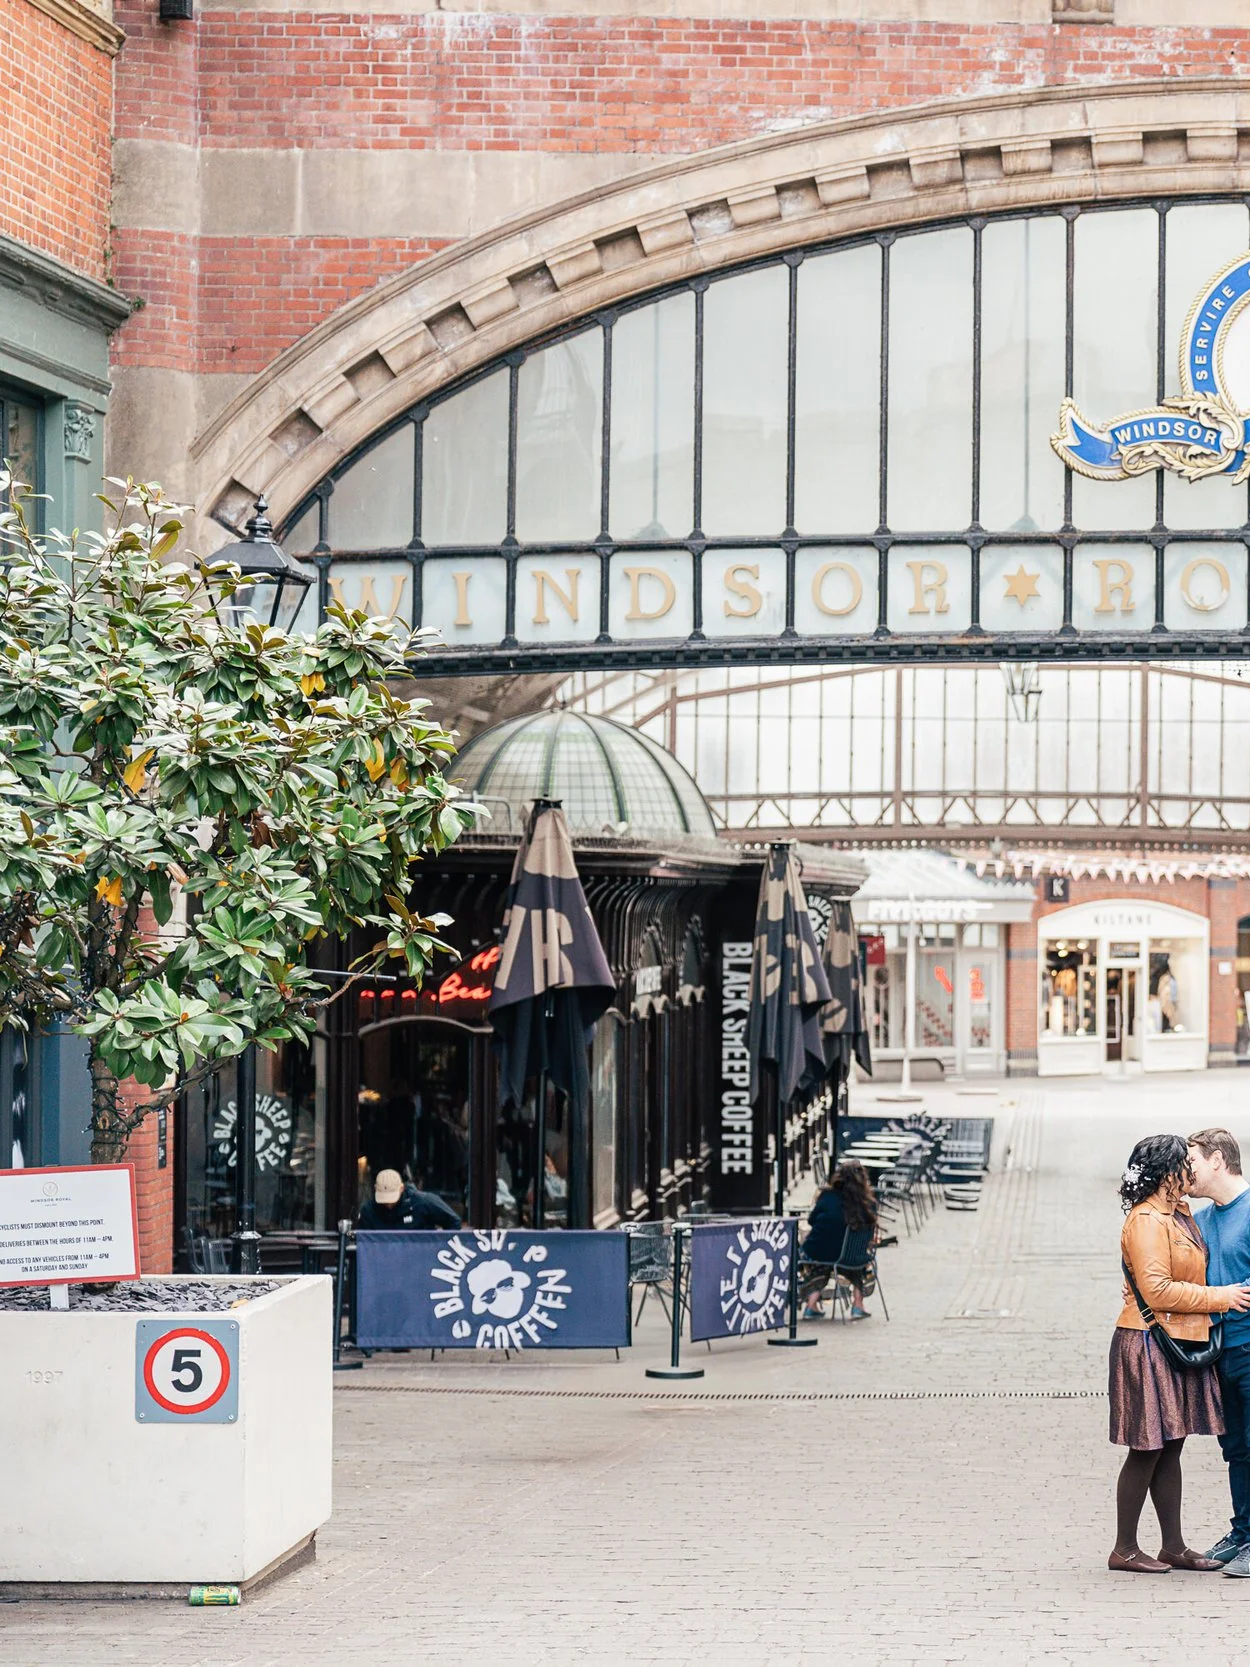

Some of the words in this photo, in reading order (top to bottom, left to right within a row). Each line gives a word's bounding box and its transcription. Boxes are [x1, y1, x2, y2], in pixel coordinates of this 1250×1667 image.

[1194, 284, 1236, 381] SERVIRE
[1114, 423, 1220, 448] WINDSOR
[328, 560, 952, 628] WINDSOR
[1052, 879, 1065, 897] K
[721, 941, 753, 1013] BLACK
[721, 1089, 753, 1175] COFFEE
[59, 1220, 78, 1228] BEYOND
[33, 1264, 58, 1272] SATURDAY
[69, 1262, 88, 1270] SUNDAY
[429, 1235, 477, 1319] BLACK
[25, 1369, 64, 1385] 1997
[170, 1348, 204, 1393] 5
